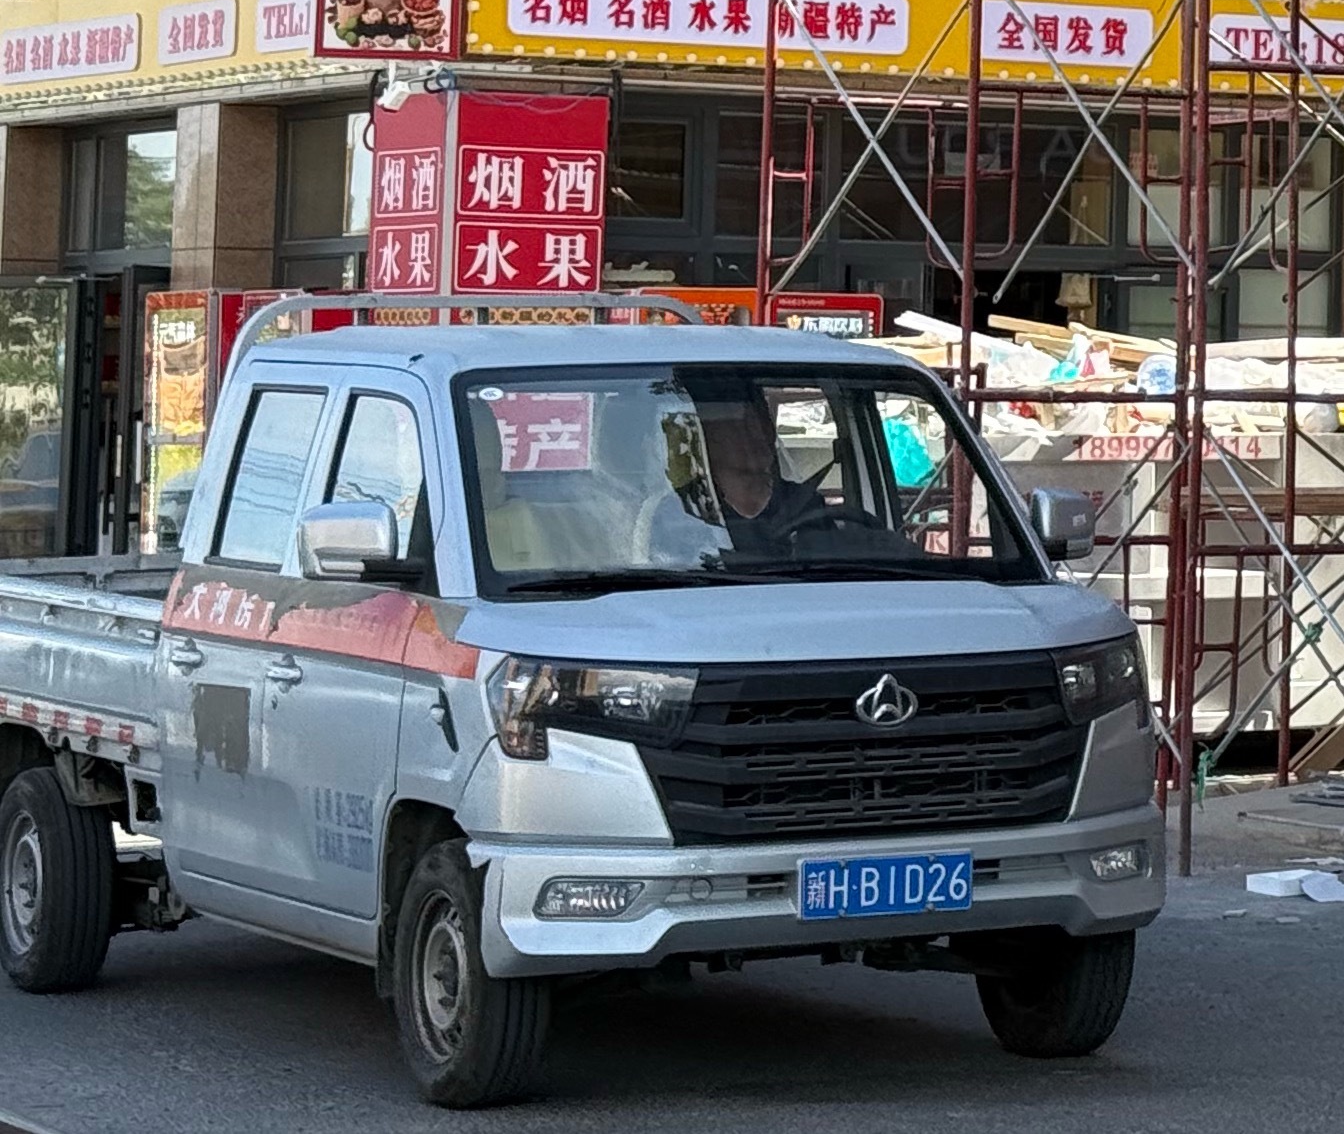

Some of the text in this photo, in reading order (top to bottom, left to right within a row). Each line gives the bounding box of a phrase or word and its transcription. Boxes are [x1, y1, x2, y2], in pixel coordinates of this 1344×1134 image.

[996, 11, 1128, 57] 全国发货
[379, 153, 437, 212] 烟酒
[467, 151, 598, 213] 烟酒
[377, 230, 432, 288] 水果
[462, 229, 593, 289] 水果
